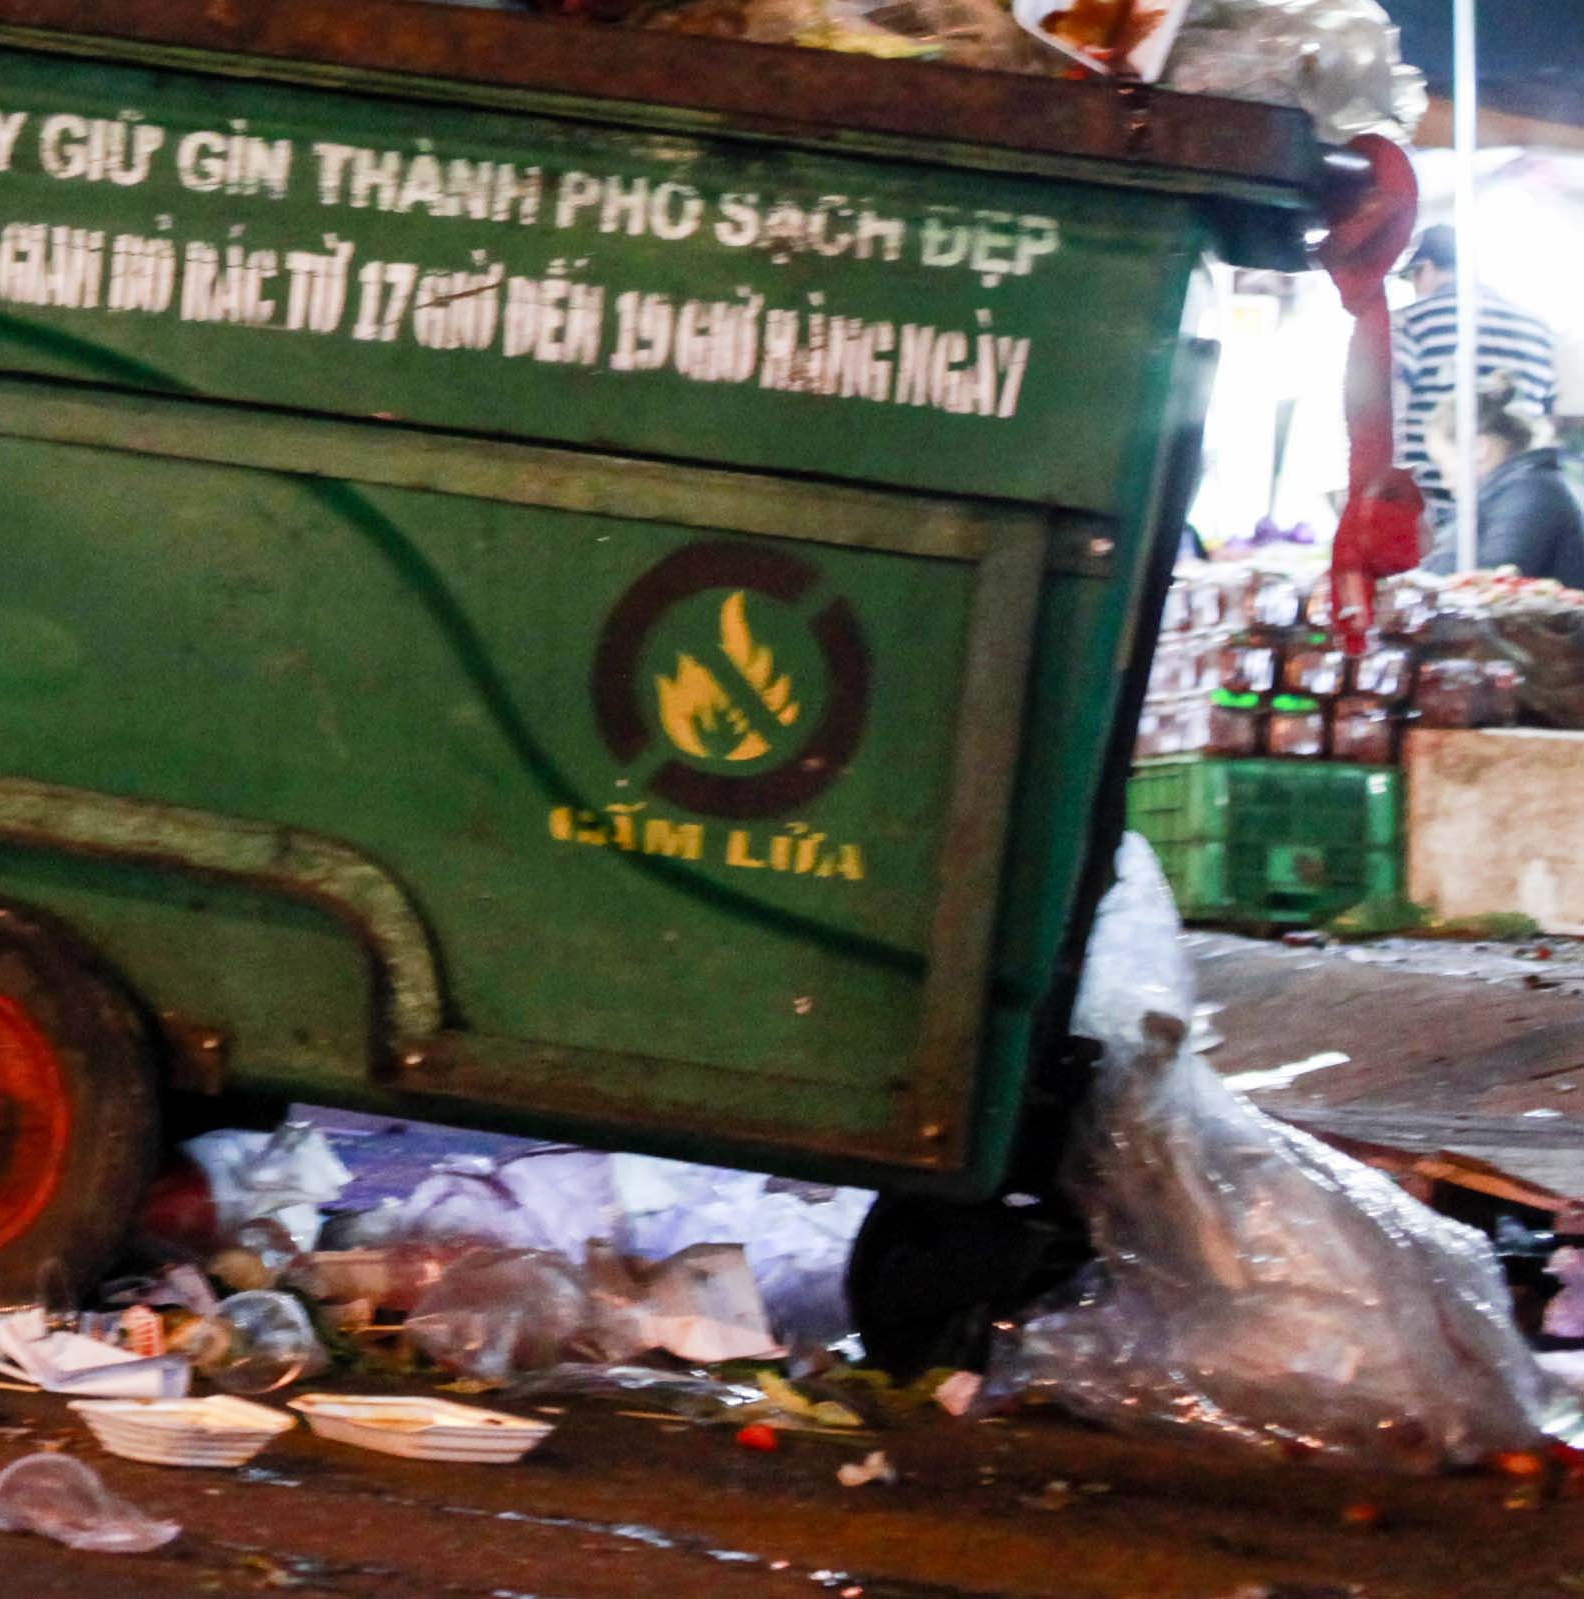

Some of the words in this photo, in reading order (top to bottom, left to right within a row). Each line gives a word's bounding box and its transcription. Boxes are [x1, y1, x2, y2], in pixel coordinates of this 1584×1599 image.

[39, 108, 165, 187] GIỮ
[177, 118, 293, 200] GÌN
[312, 138, 542, 225] THÀNH
[714, 193, 906, 264] SẠCH
[921, 204, 1060, 289] ĐẸP
[180, 223, 279, 324] RÁC
[285, 233, 355, 334] TỪ
[352, 261, 418, 342] 17
[894, 308, 1031, 419] NGÀY
